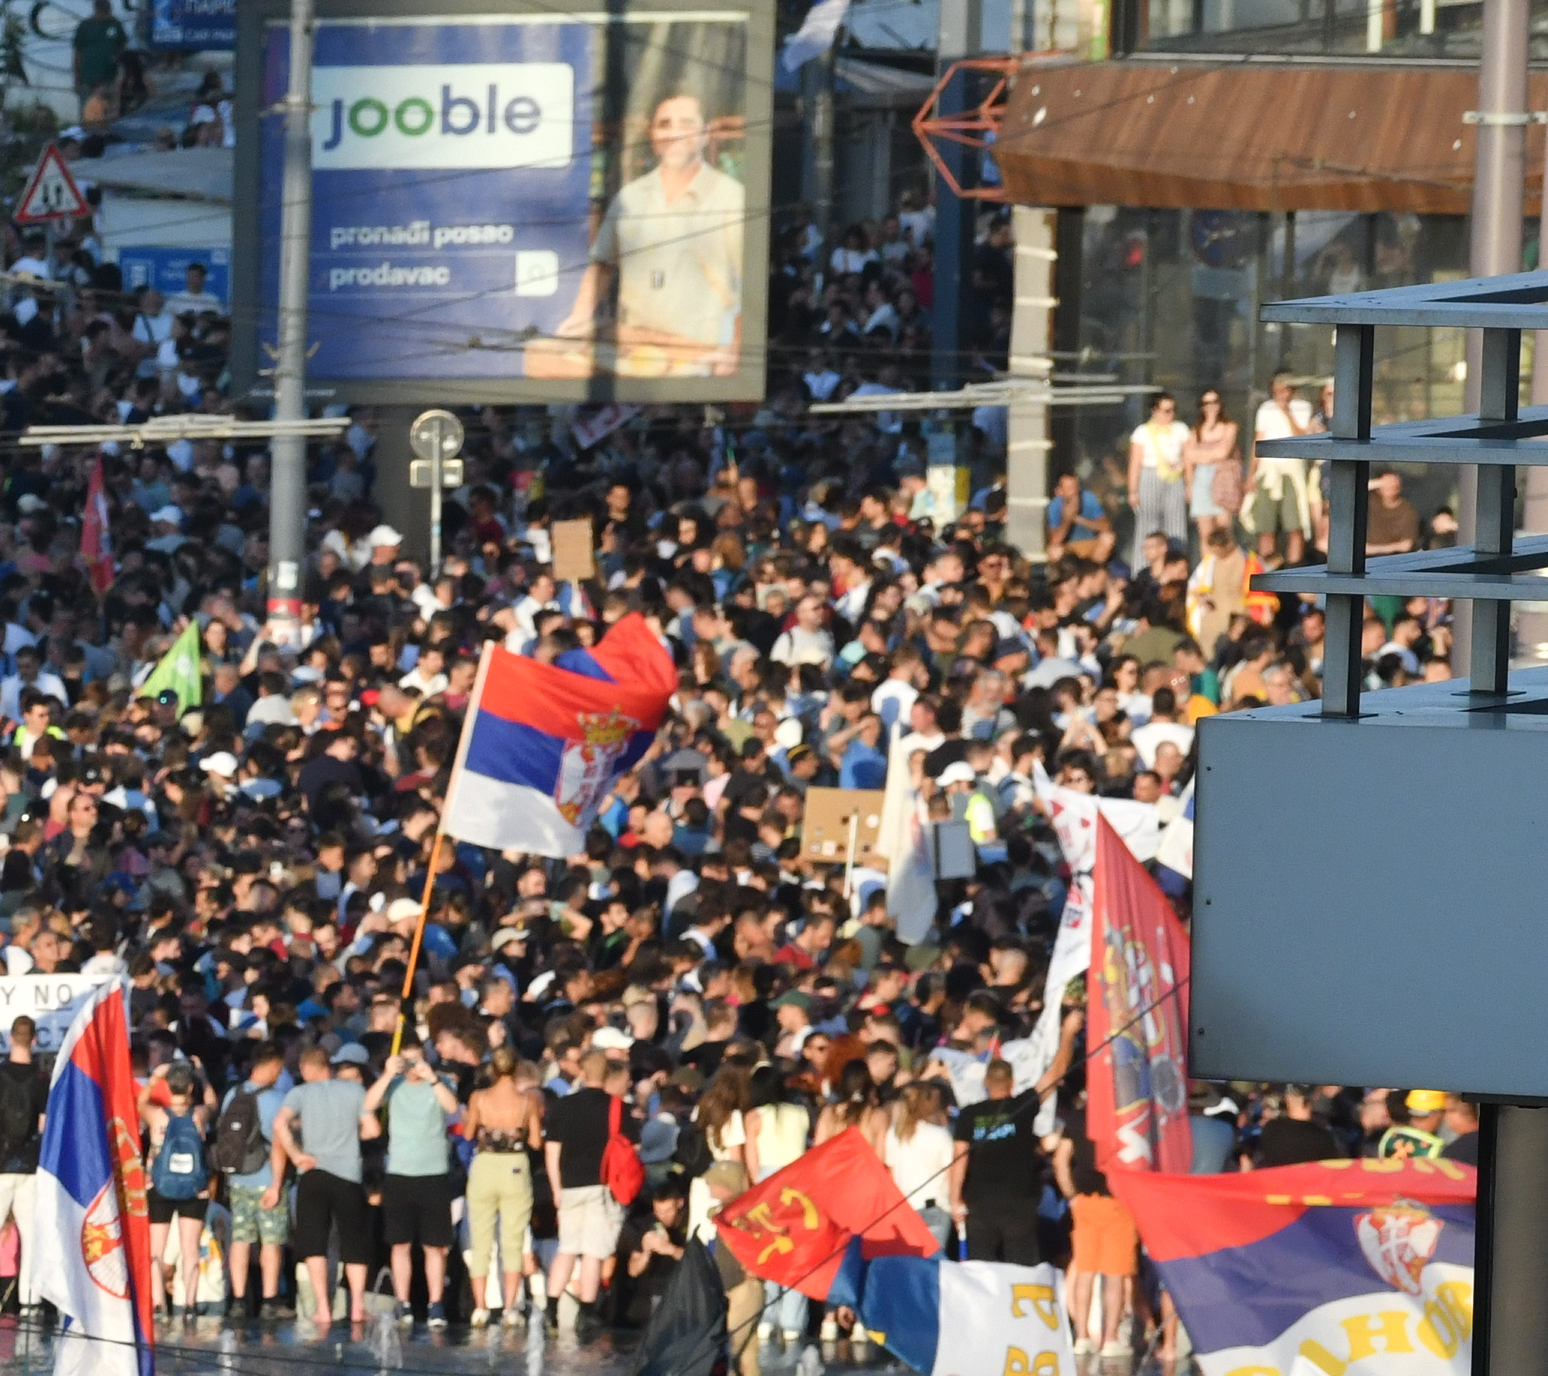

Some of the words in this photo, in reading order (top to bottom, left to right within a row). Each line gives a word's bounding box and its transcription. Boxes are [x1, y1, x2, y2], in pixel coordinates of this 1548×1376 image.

[322, 84, 541, 151] jooble
[330, 221, 430, 250] pronađi
[434, 224, 514, 250] posao
[330, 262, 450, 291] prodavac
[34, 984, 72, 1008] NO
